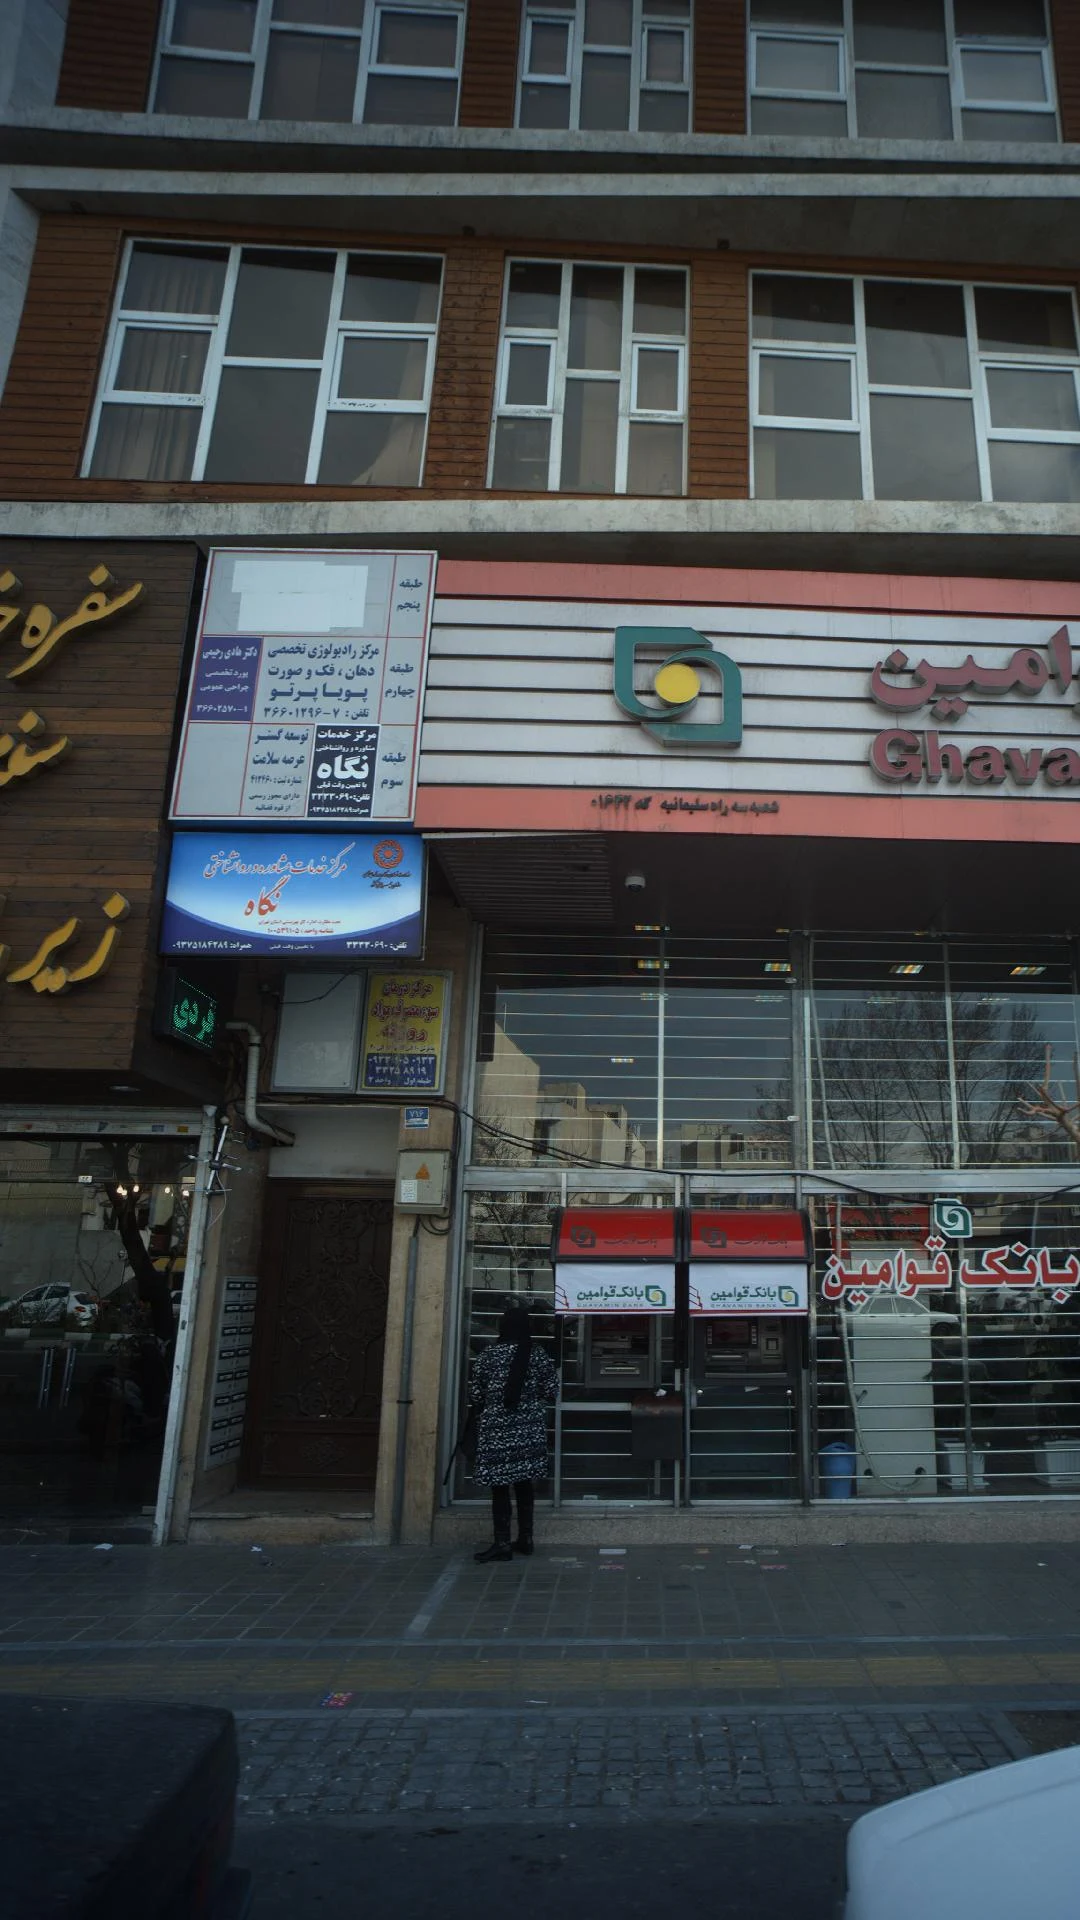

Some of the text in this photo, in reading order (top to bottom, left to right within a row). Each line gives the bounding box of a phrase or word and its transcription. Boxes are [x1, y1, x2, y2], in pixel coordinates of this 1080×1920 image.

[399, 578, 423, 591] طبقه
[396, 601, 420, 612] پنجم
[6, 563, 145, 680] سفره
[242, 646, 258, 660] دکتر
[268, 643, 380, 660] مرکز رادیولوژی تخصصی
[205, 668, 233, 677] تخصصی
[268, 666, 303, 680] صورت
[305, 669, 312, 680] و
[315, 664, 335, 676] فک
[389, 663, 414, 676] طبقه
[872, 624, 1080, 722] امین
[225, 683, 249, 692] جراحی
[269, 682, 368, 703] پویا پرتو
[385, 685, 415, 699] چهارم
[254, 728, 309, 744] توسعه گستر
[317, 729, 377, 741] مرکز خدمات
[315, 744, 349, 752] روانشناختی
[355, 745, 376, 753] مشاوره
[253, 751, 280, 765] سلامت
[382, 752, 407, 765] طبقه
[317, 754, 369, 780] نگاه
[317, 781, 331, 789] قبلی
[381, 778, 403, 789] سوم
[660, 796, 709, 815] سلیمانیه
[711, 799, 728, 817] راه
[732, 800, 748, 813] سه
[750, 799, 779, 817] شعبه
[203, 850, 253, 878] روانشناختی
[259, 853, 291, 874] مشاوره
[290, 855, 327, 874] خدمات
[327, 841, 356, 879] مرکز
[244, 875, 292, 917] نگاه
[822, 1235, 1080, 1305] بانک قوامین
[577, 1285, 644, 1301] بانک قوامین
[710, 1286, 777, 1301] بانک قوامین
